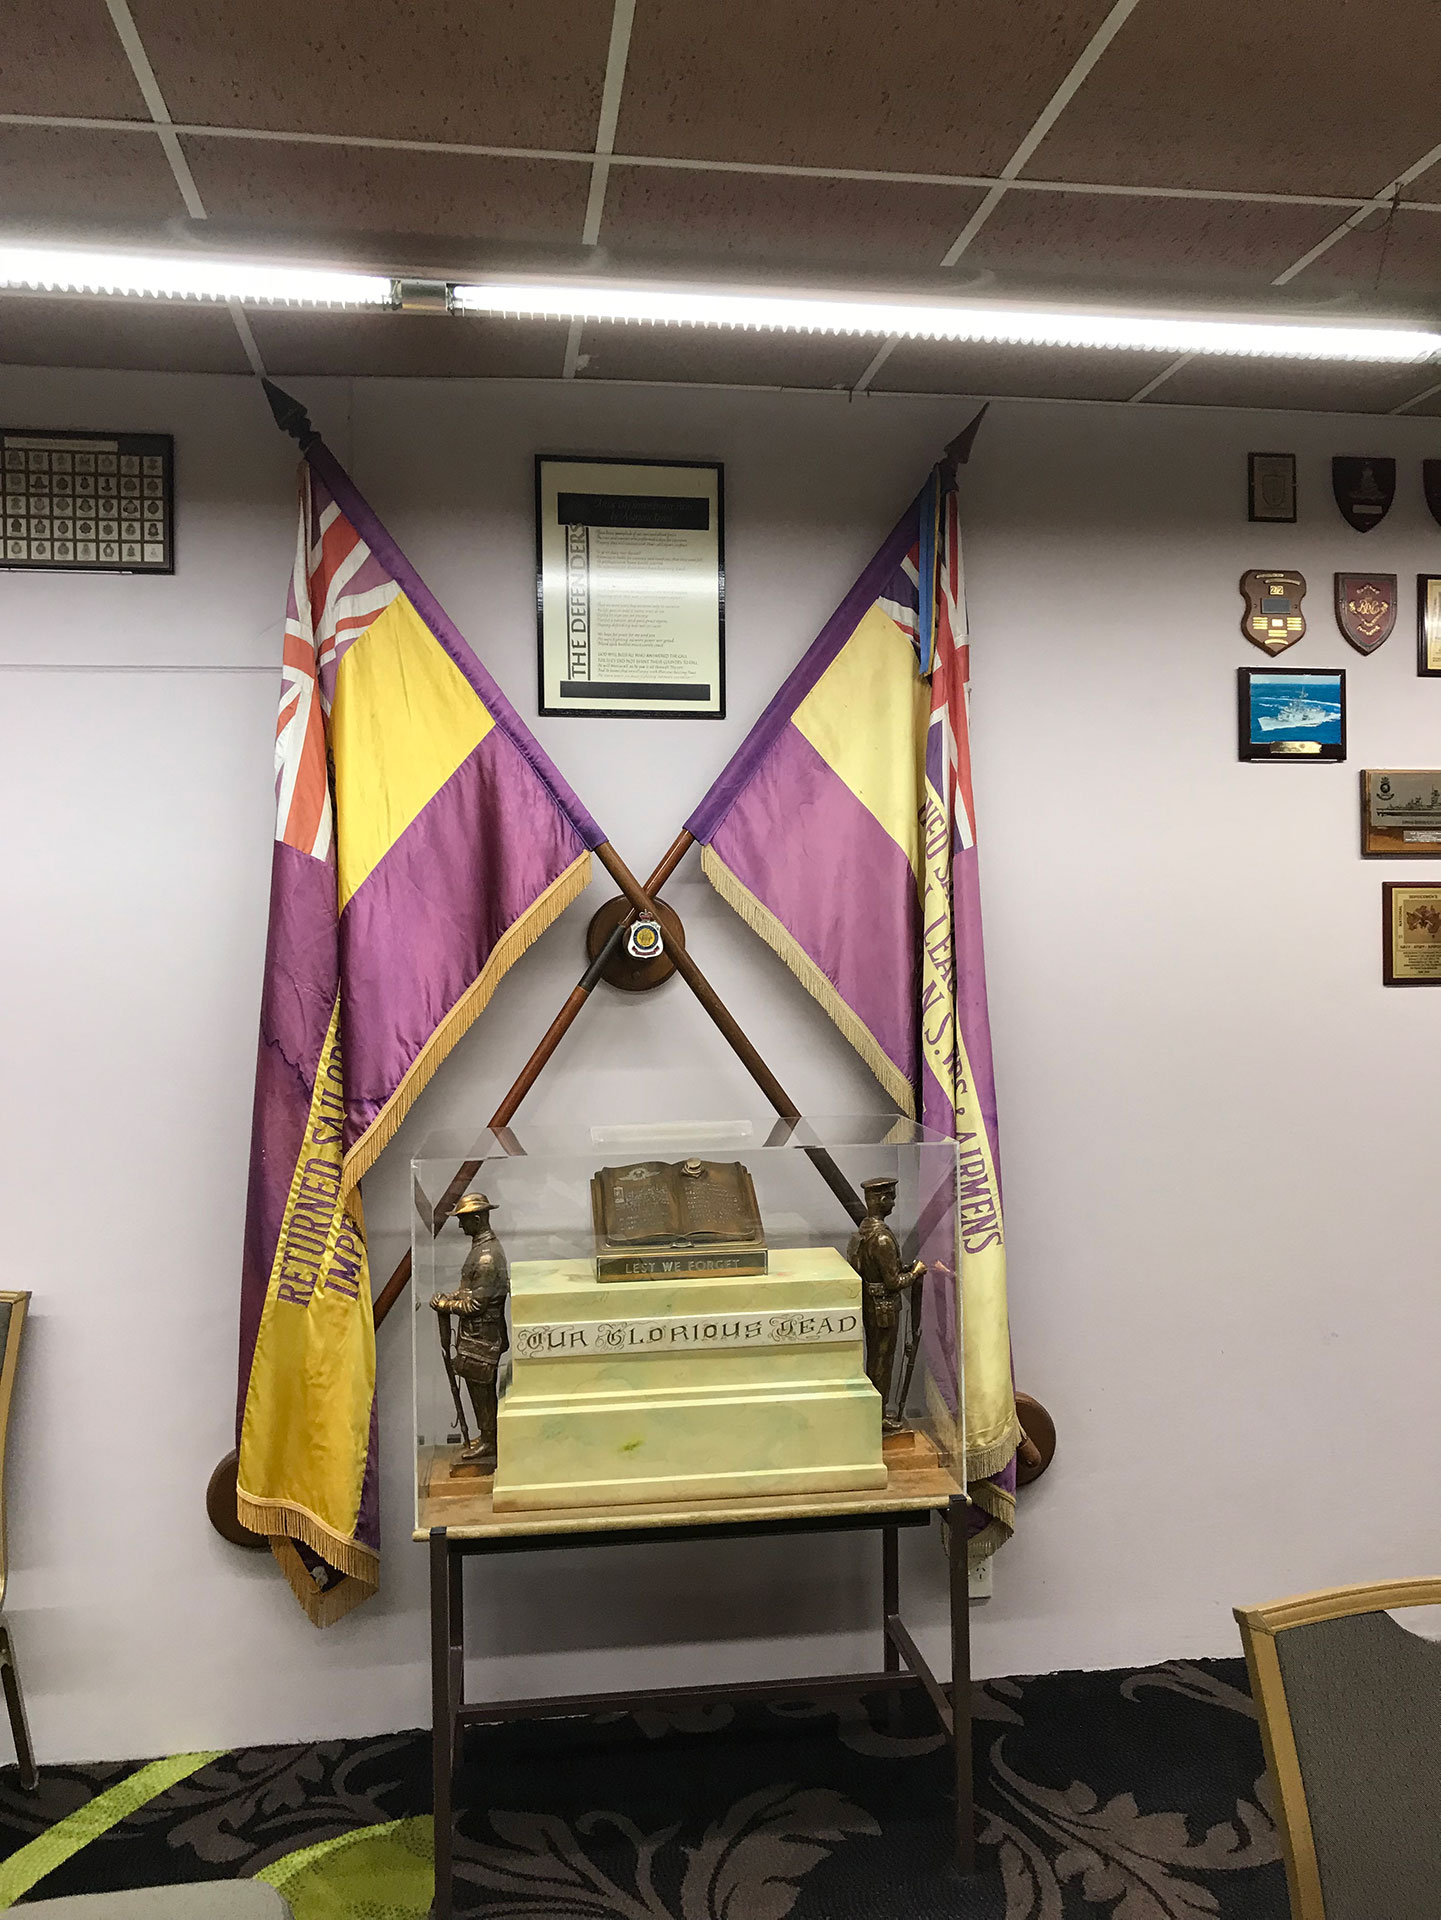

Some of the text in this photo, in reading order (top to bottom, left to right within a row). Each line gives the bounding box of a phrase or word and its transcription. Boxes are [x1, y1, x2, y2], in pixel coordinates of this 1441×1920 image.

[569, 522, 587, 679] THE DEFENDERS
[277, 1026, 343, 1309] RETURNED SAILO
[956, 1131, 1004, 1255] AIRMENS
[625, 1259, 740, 1274] LEST WE FORGET
